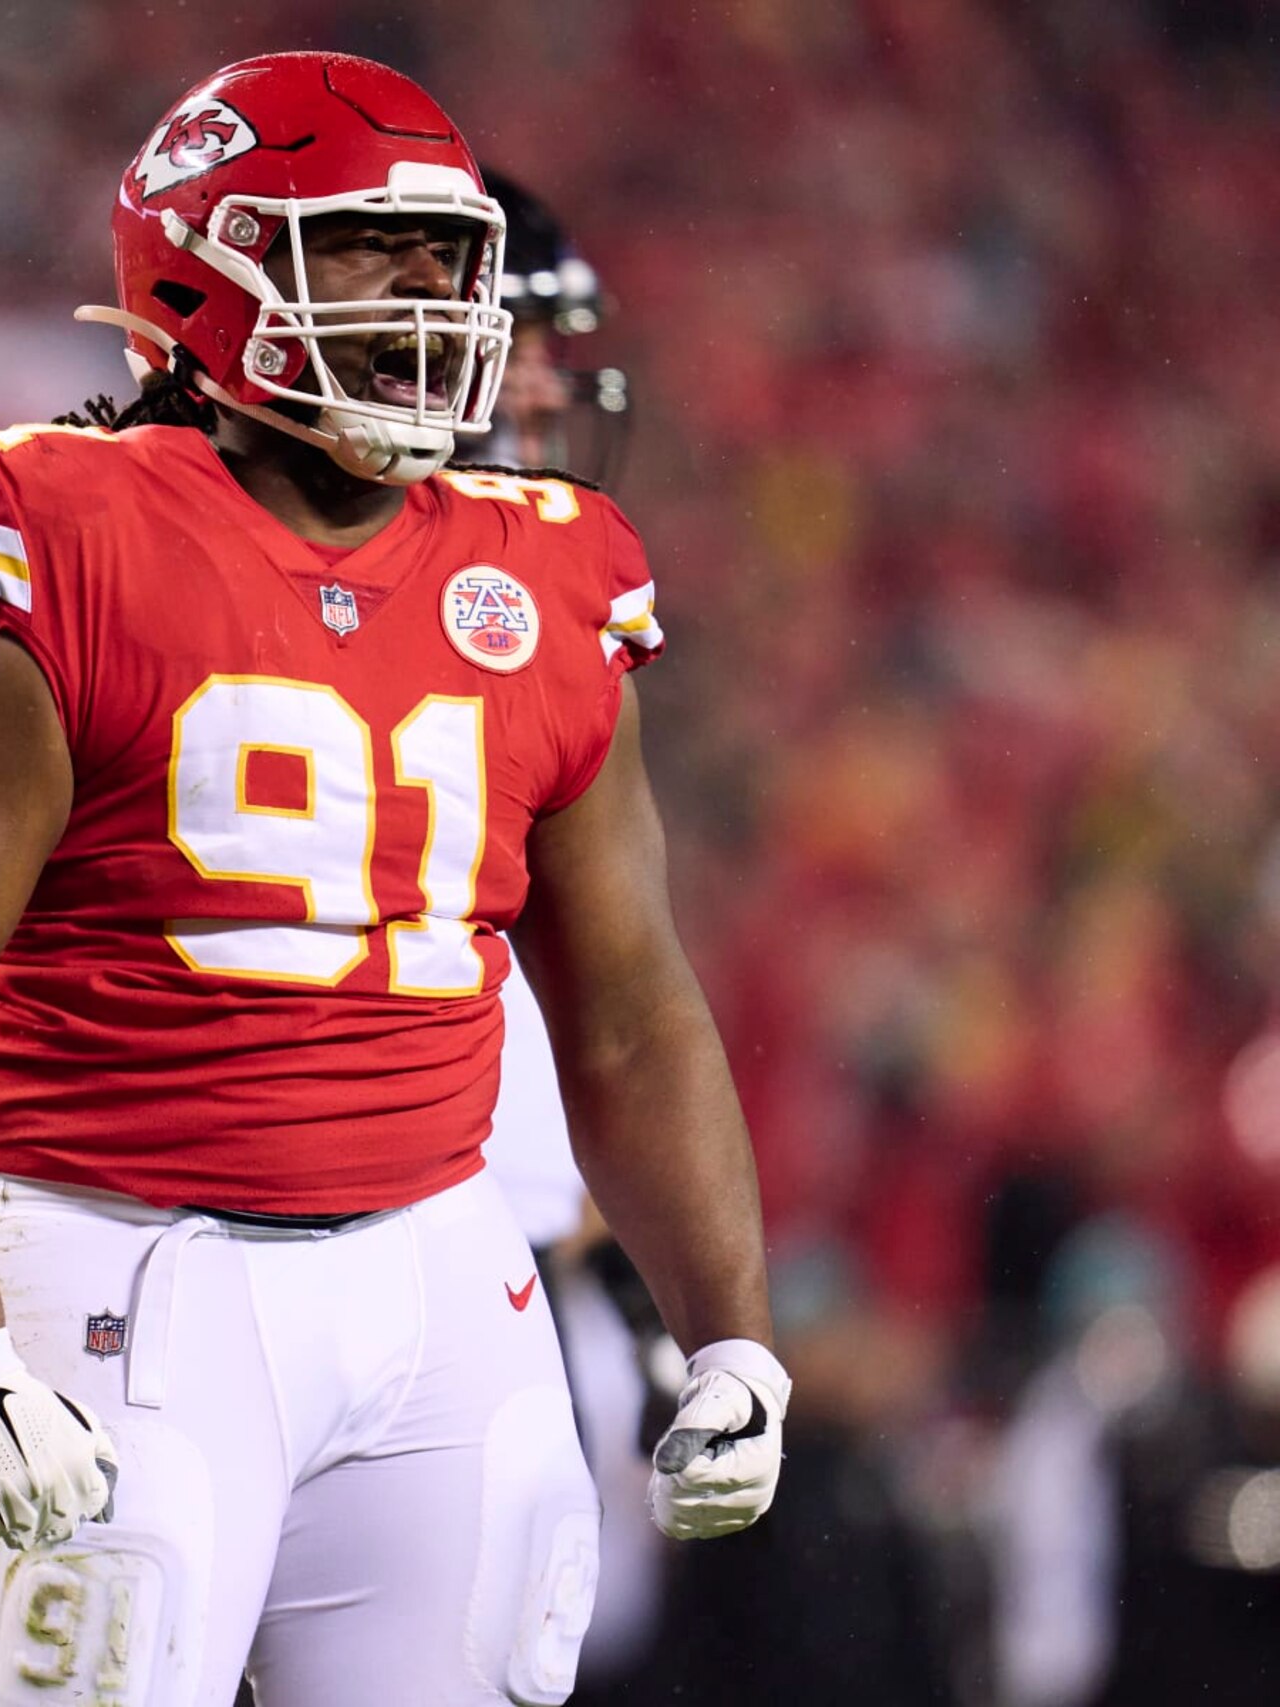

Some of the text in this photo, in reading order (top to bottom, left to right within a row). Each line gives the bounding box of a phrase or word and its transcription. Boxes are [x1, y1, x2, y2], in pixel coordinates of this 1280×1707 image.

[154, 109, 239, 168] KC
[456, 578, 528, 631] A
[163, 673, 486, 997] 91
[89, 1330, 119, 1350] NFL
[18, 1564, 140, 1692] 91
